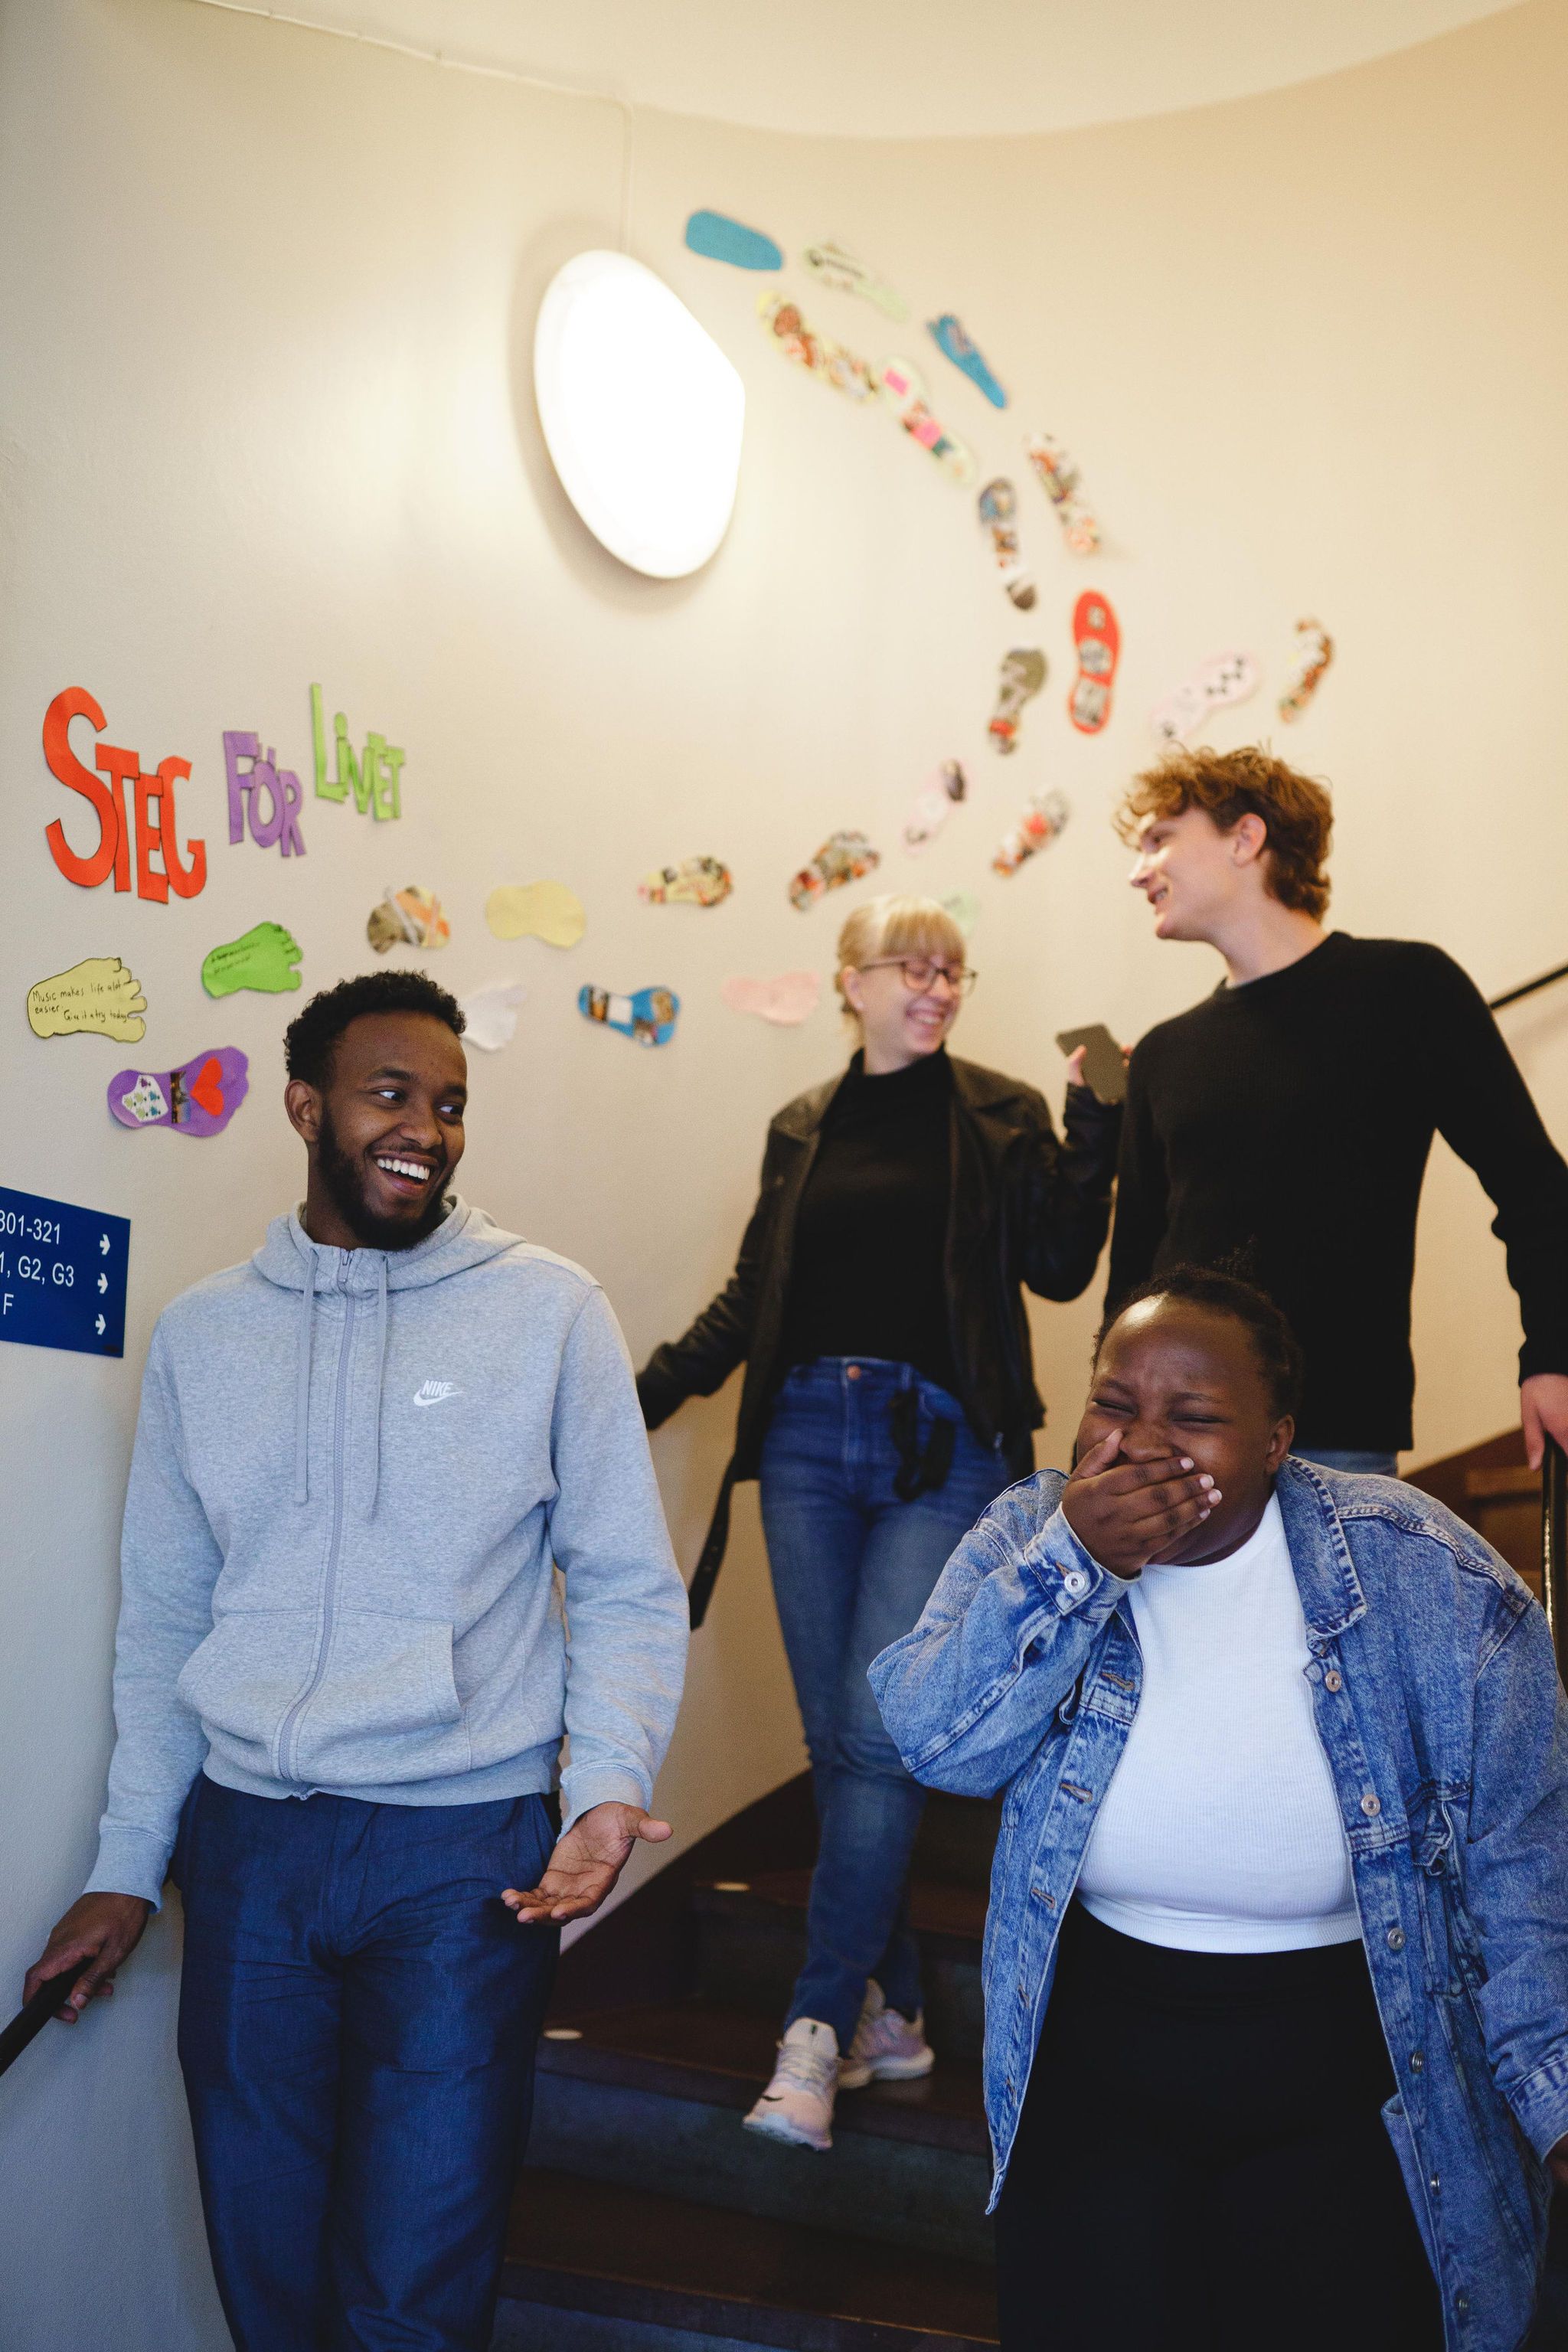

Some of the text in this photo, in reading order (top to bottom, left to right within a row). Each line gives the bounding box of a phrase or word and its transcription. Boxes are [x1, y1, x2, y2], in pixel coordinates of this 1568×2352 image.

[43, 686, 207, 904] STEG
[60, 985, 84, 998] makes
[90, 982, 104, 995] life
[18, 1256, 45, 1285] G2,
[52, 1263, 74, 1287] G3
[3, 1292, 15, 1315] F
[422, 1380, 453, 1397] NIKE
